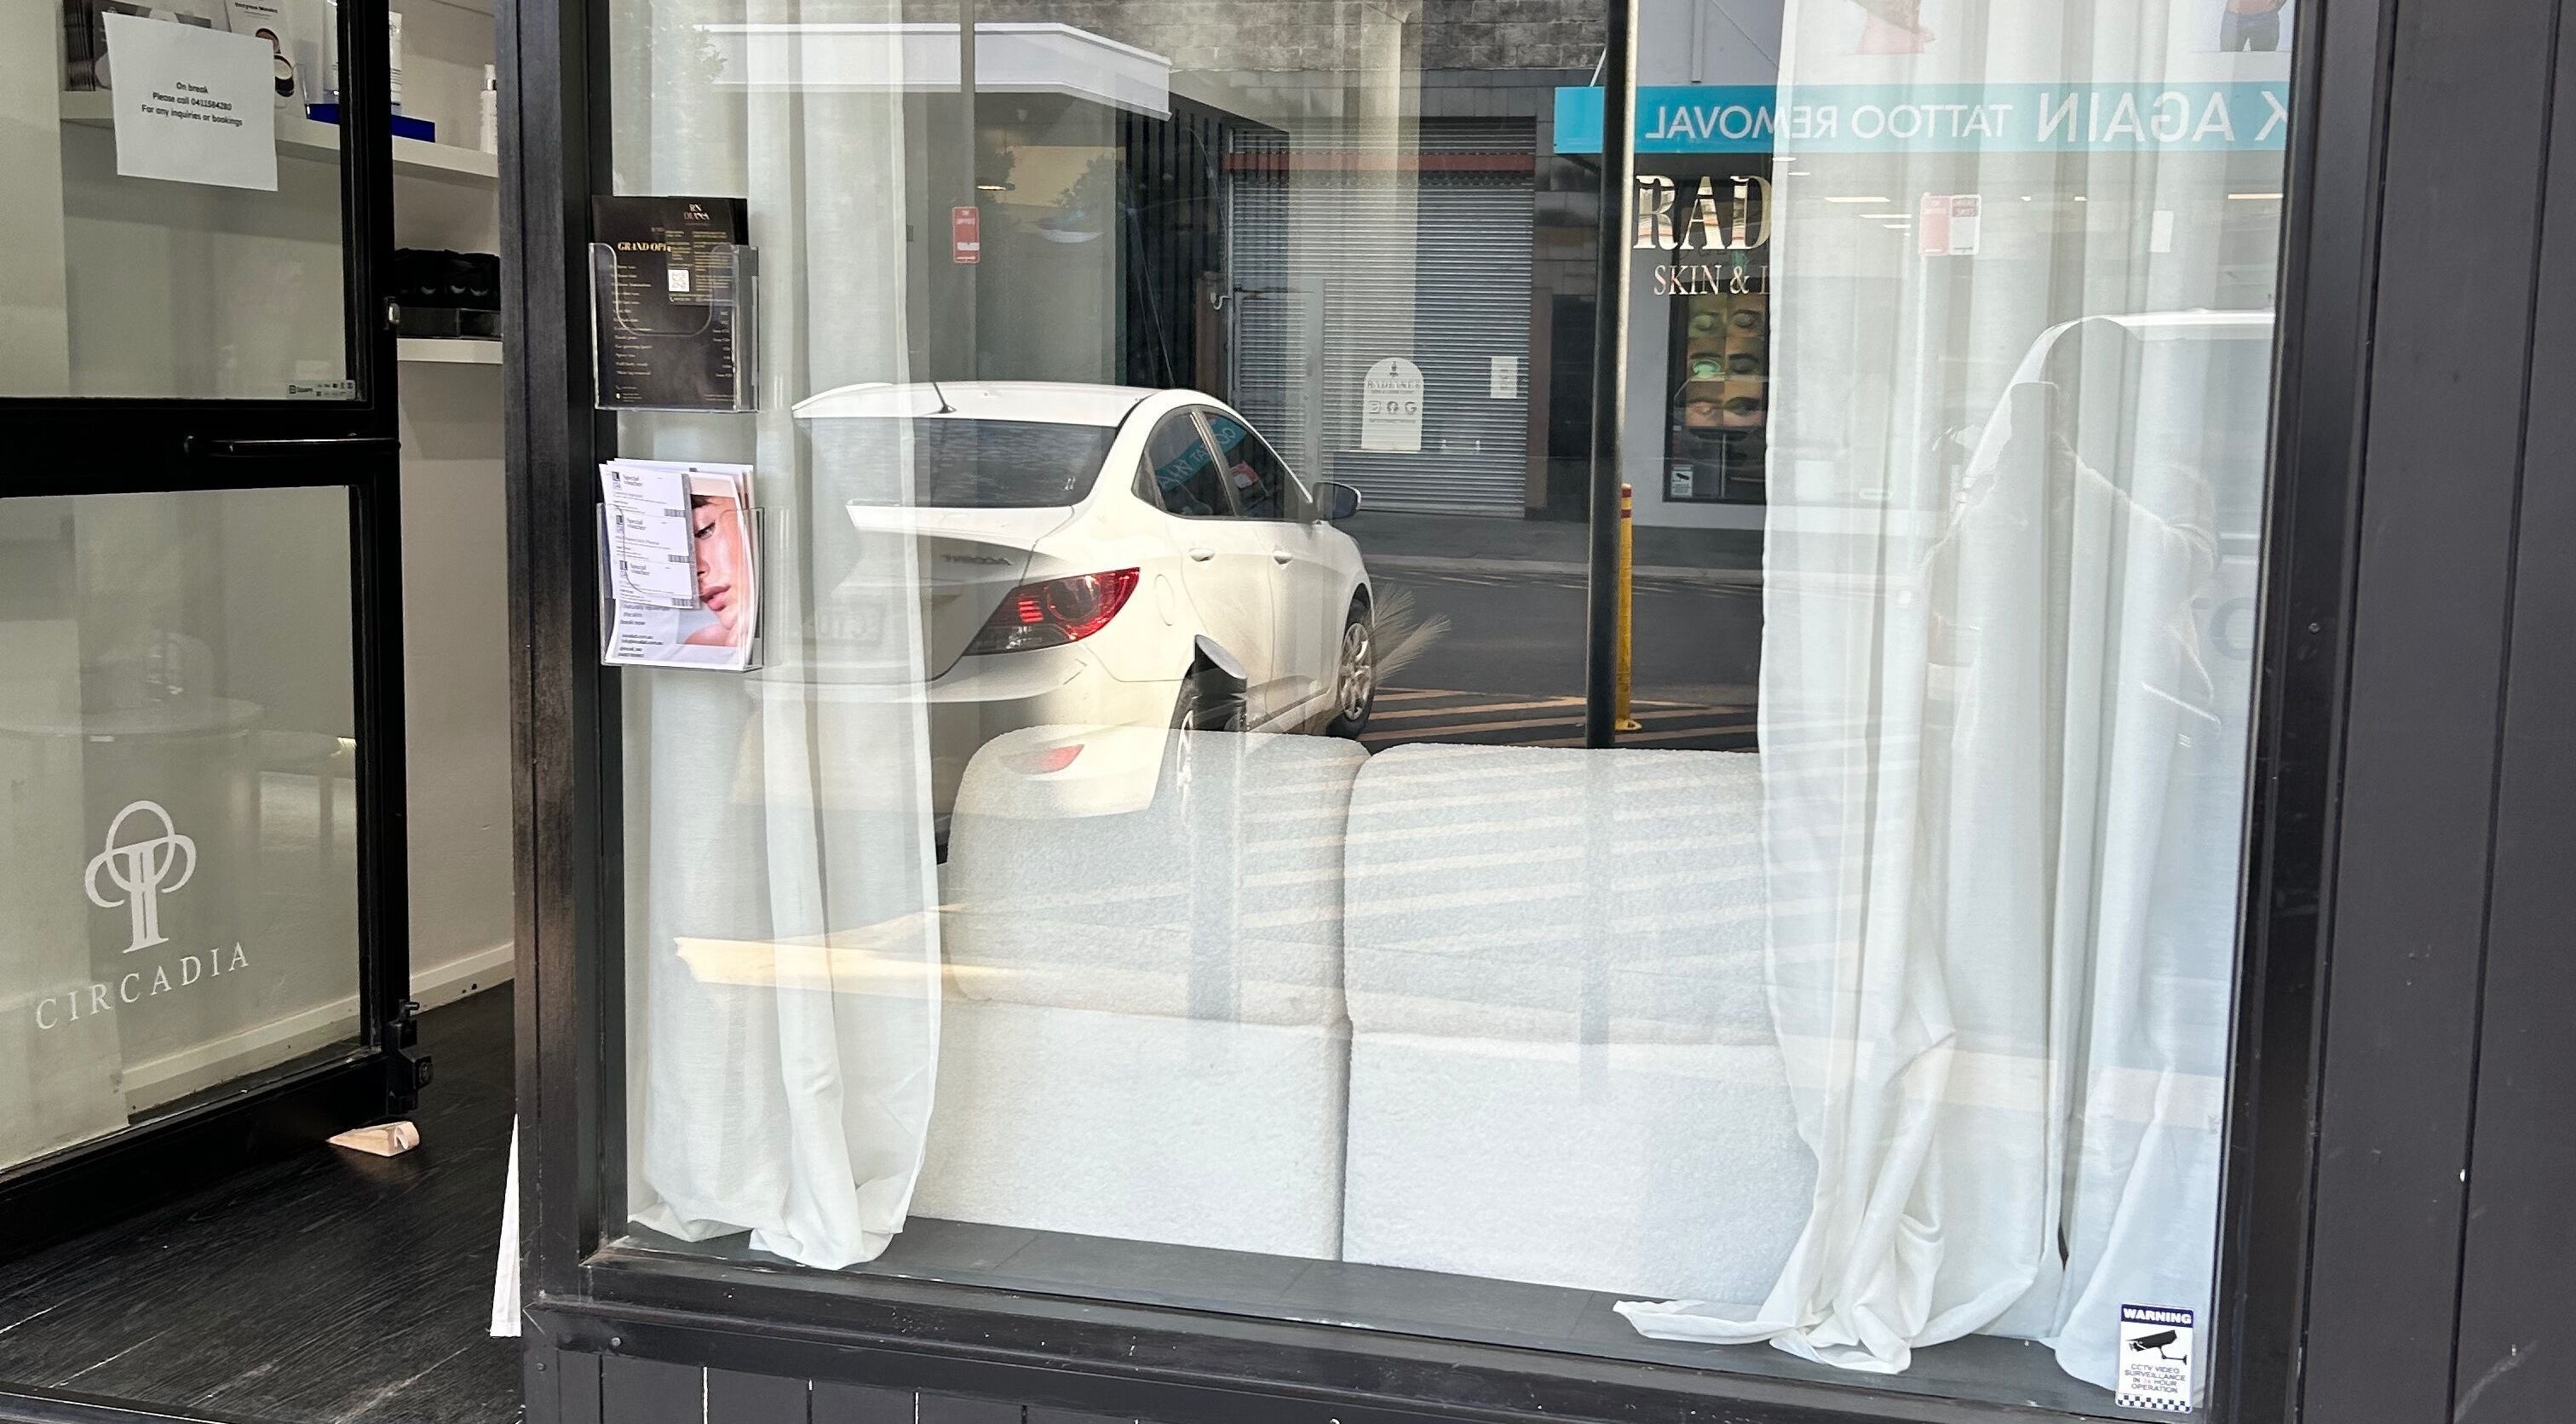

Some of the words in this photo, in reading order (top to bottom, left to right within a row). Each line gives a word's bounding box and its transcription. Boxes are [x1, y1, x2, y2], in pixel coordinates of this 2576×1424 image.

[152, 92, 175, 102] Please
[141, 104, 153, 112] For
[156, 108, 169, 117] any
[212, 114, 243, 127] bookings
[618, 241, 649, 251] GRAND
[1654, 264, 1722, 296] SKIN
[1729, 266, 1749, 295] &
[35, 941, 250, 1030] CIRCADIA
[2123, 1307, 2192, 1324] WARNING
[2125, 1369, 2186, 1381] SURVEILLANCE
[2130, 1383, 2178, 1393] OPERATION
